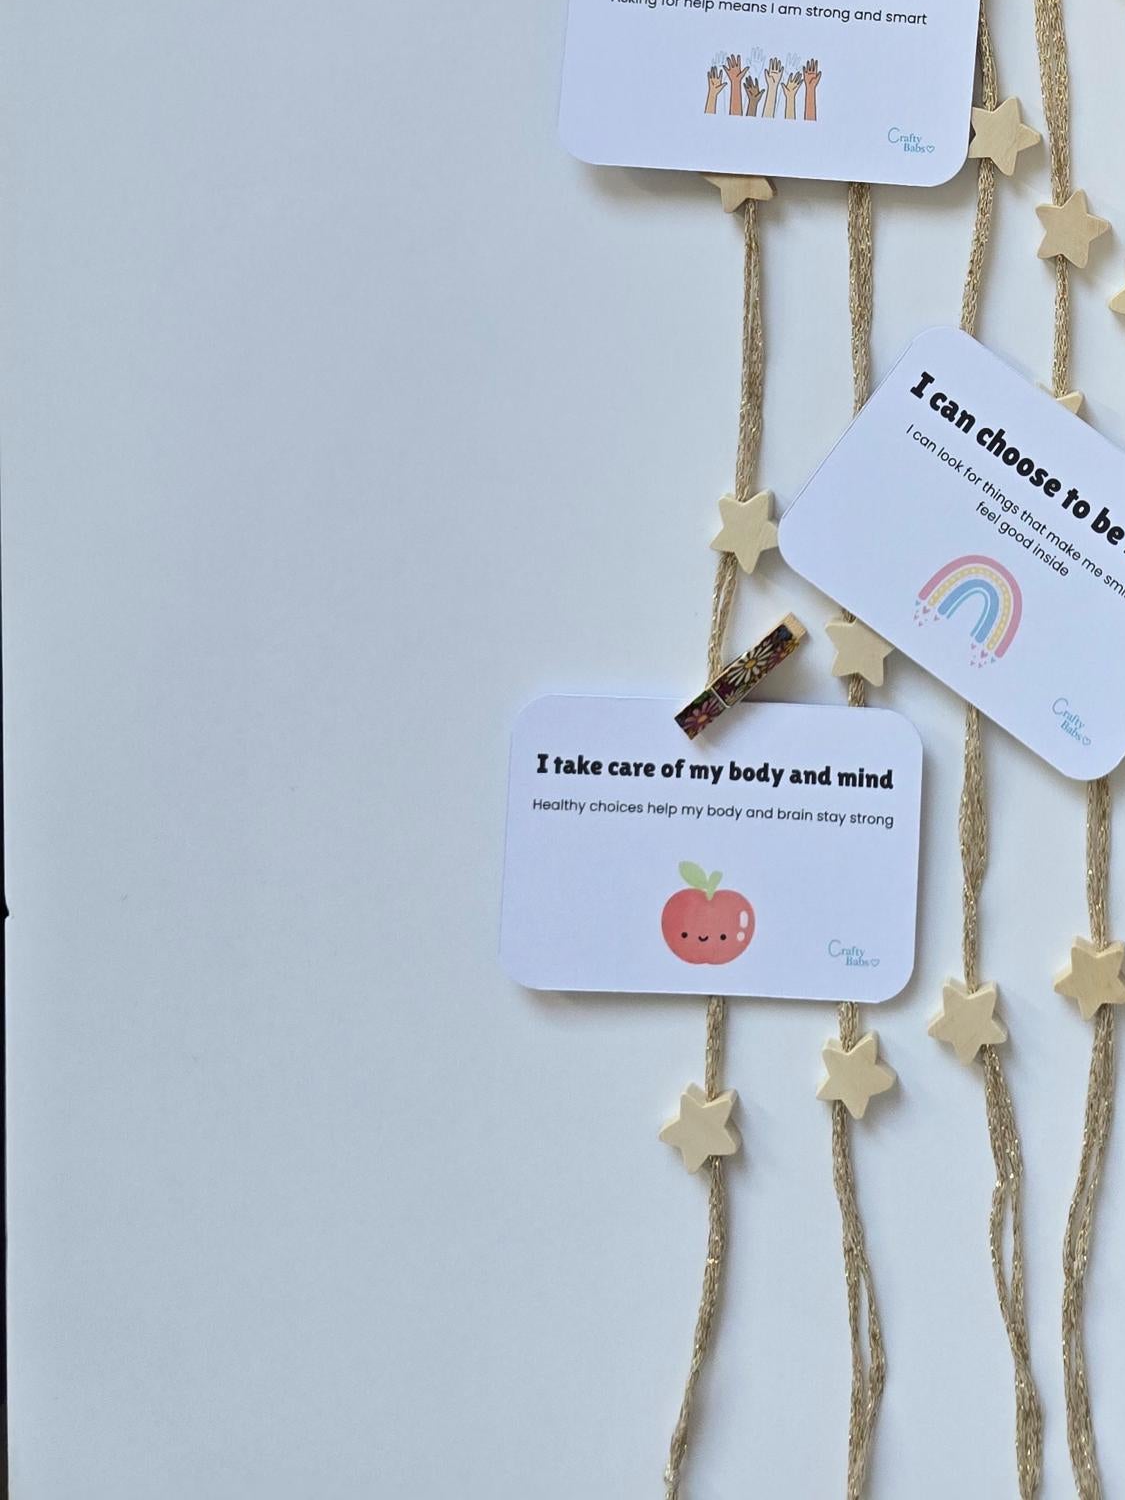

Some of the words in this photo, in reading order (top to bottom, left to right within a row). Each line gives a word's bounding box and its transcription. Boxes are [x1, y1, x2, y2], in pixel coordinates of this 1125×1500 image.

[717, 0, 767, 13] means
[770, 2, 774, 14] I
[777, 4, 802, 16] am
[804, 5, 850, 23] strong
[853, 9, 882, 21] and
[884, 12, 927, 25] smart
[888, 127, 922, 143] Crafty
[910, 371, 935, 399] I
[928, 391, 976, 434] can
[975, 426, 1062, 498] choose
[1060, 487, 1091, 519] to
[1089, 507, 1125, 546] be
[905, 423, 914, 434] I
[912, 430, 937, 453] can
[936, 446, 964, 473] look
[962, 466, 982, 485] for
[981, 480, 1019, 514] things
[1019, 509, 1047, 535] that
[1045, 530, 1081, 561] make
[1080, 557, 1103, 577] me
[975, 500, 1001, 524] feel
[997, 521, 1034, 549] good
[1031, 542, 1069, 576] inside
[536, 752, 549, 774] I
[552, 753, 603, 775] take
[607, 760, 656, 777] care
[660, 757, 686, 778] of
[688, 763, 724, 785] my
[728, 760, 785, 788] body
[788, 764, 832, 786] and
[836, 767, 893, 790] mind
[532, 798, 586, 815] Healthy
[588, 799, 643, 813] choices
[646, 801, 678, 818] help
[680, 805, 704, 819] my
[706, 803, 743, 821] body
[745, 806, 773, 819] and
[776, 807, 813, 821] brain
[816, 810, 846, 827] stay
[849, 812, 894, 829] strong
[828, 939, 865, 957] Crafty
